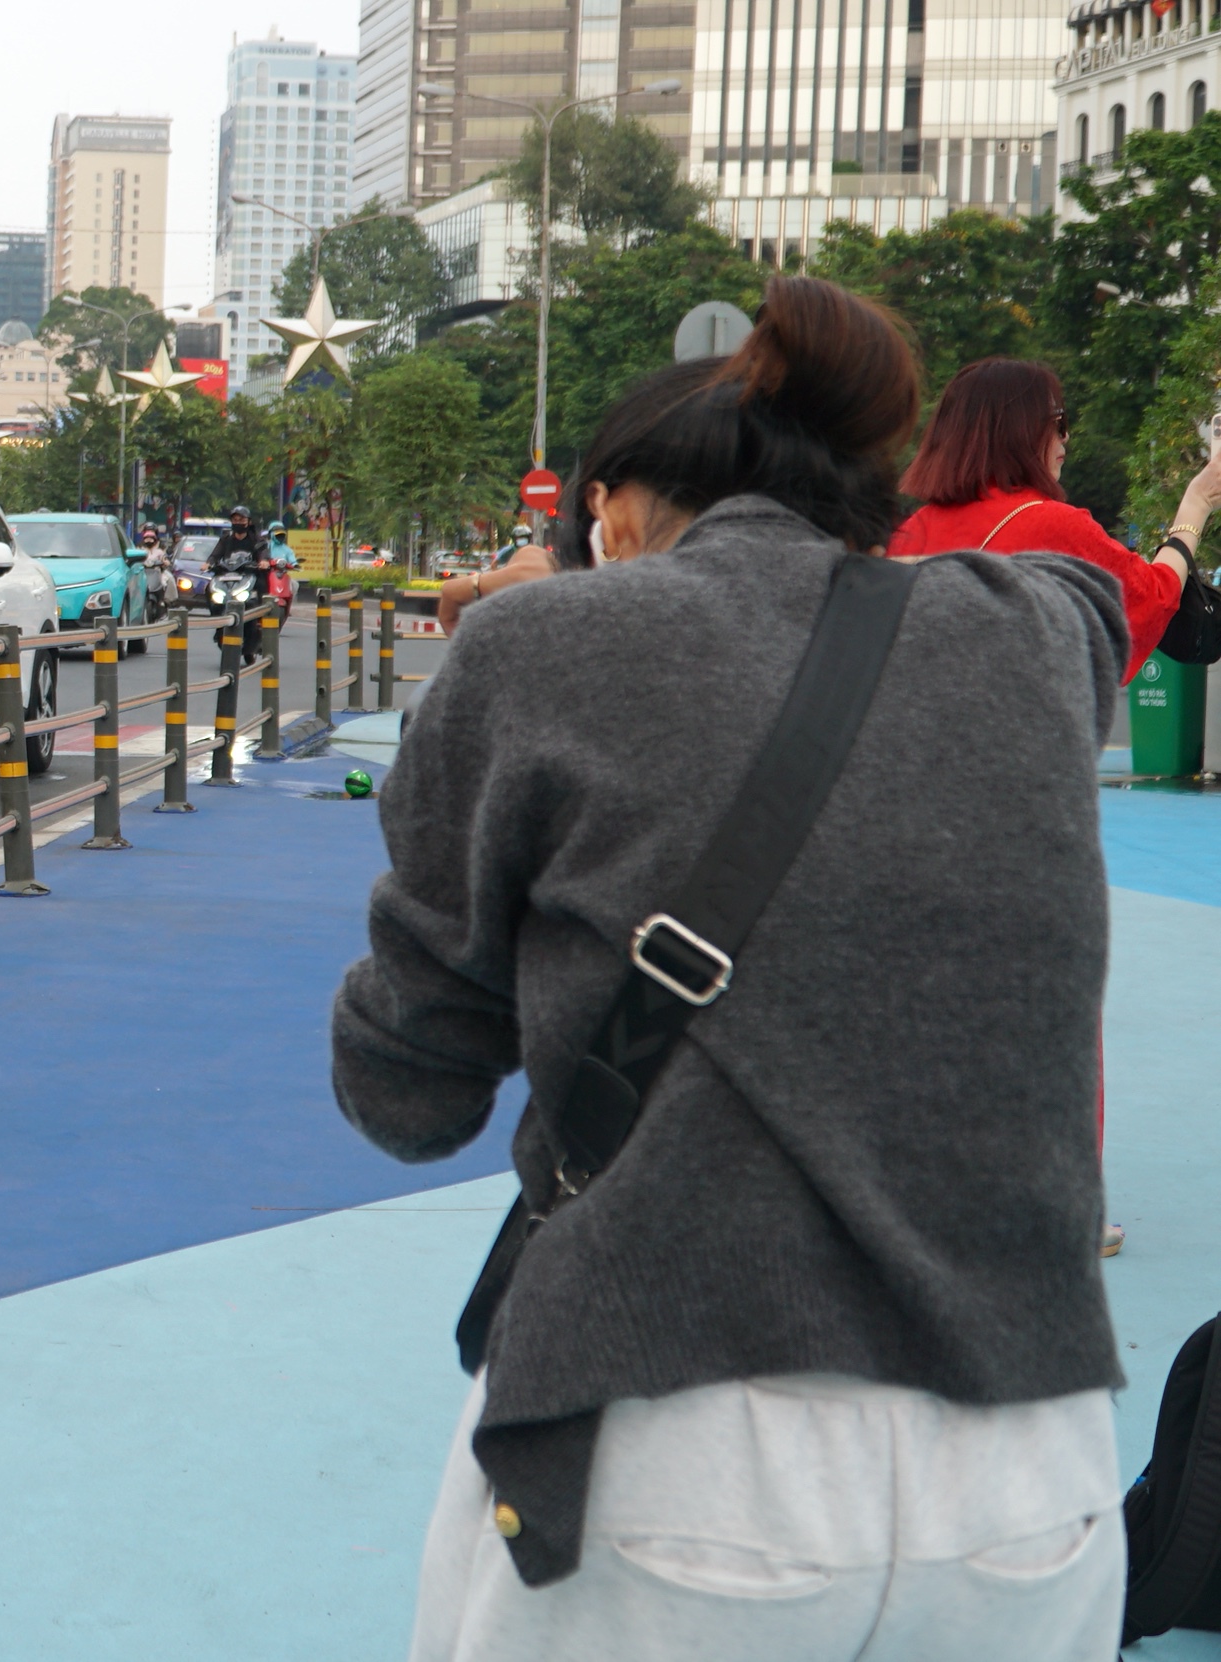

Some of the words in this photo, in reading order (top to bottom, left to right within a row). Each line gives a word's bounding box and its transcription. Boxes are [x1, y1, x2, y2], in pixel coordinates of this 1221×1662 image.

[259, 47, 312, 56] SHERATON
[1055, 36, 1128, 82] CAPITAL
[204, 363, 224, 375] 2026
